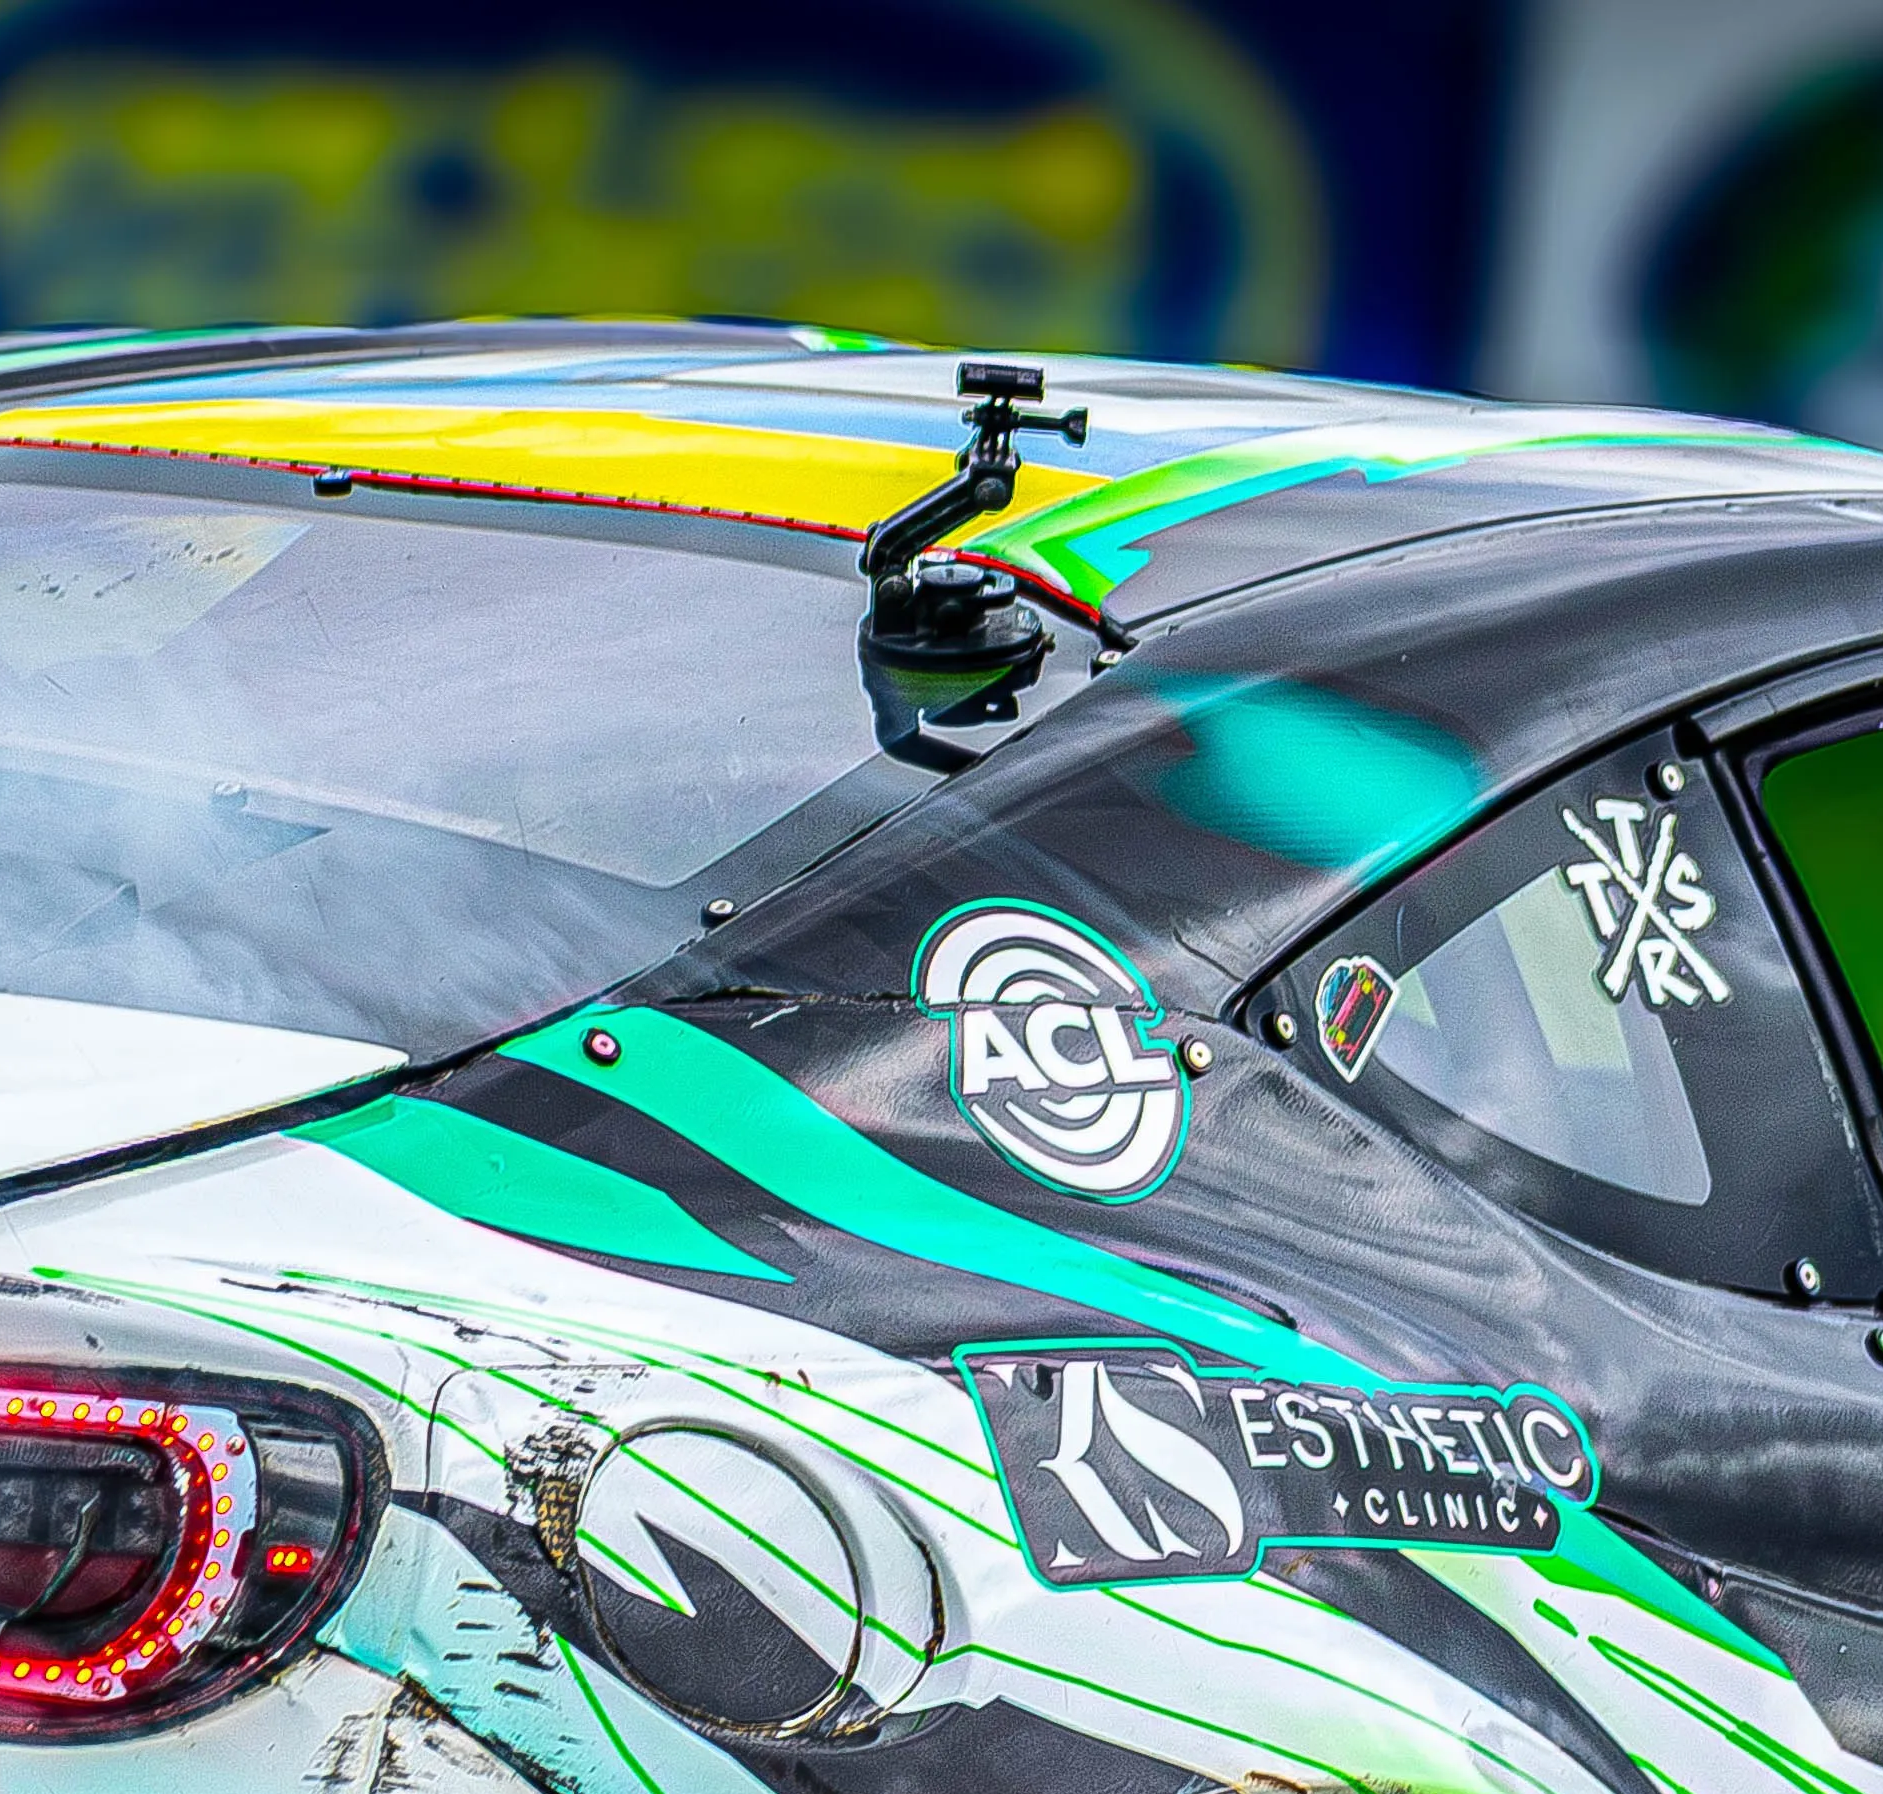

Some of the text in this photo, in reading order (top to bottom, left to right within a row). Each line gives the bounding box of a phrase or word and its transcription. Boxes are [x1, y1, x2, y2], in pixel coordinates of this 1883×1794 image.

[962, 1002, 1174, 1096] ACL
[1229, 1386, 1584, 1488] ESTHETIC
[1363, 1488, 1520, 1533] CLINIC
